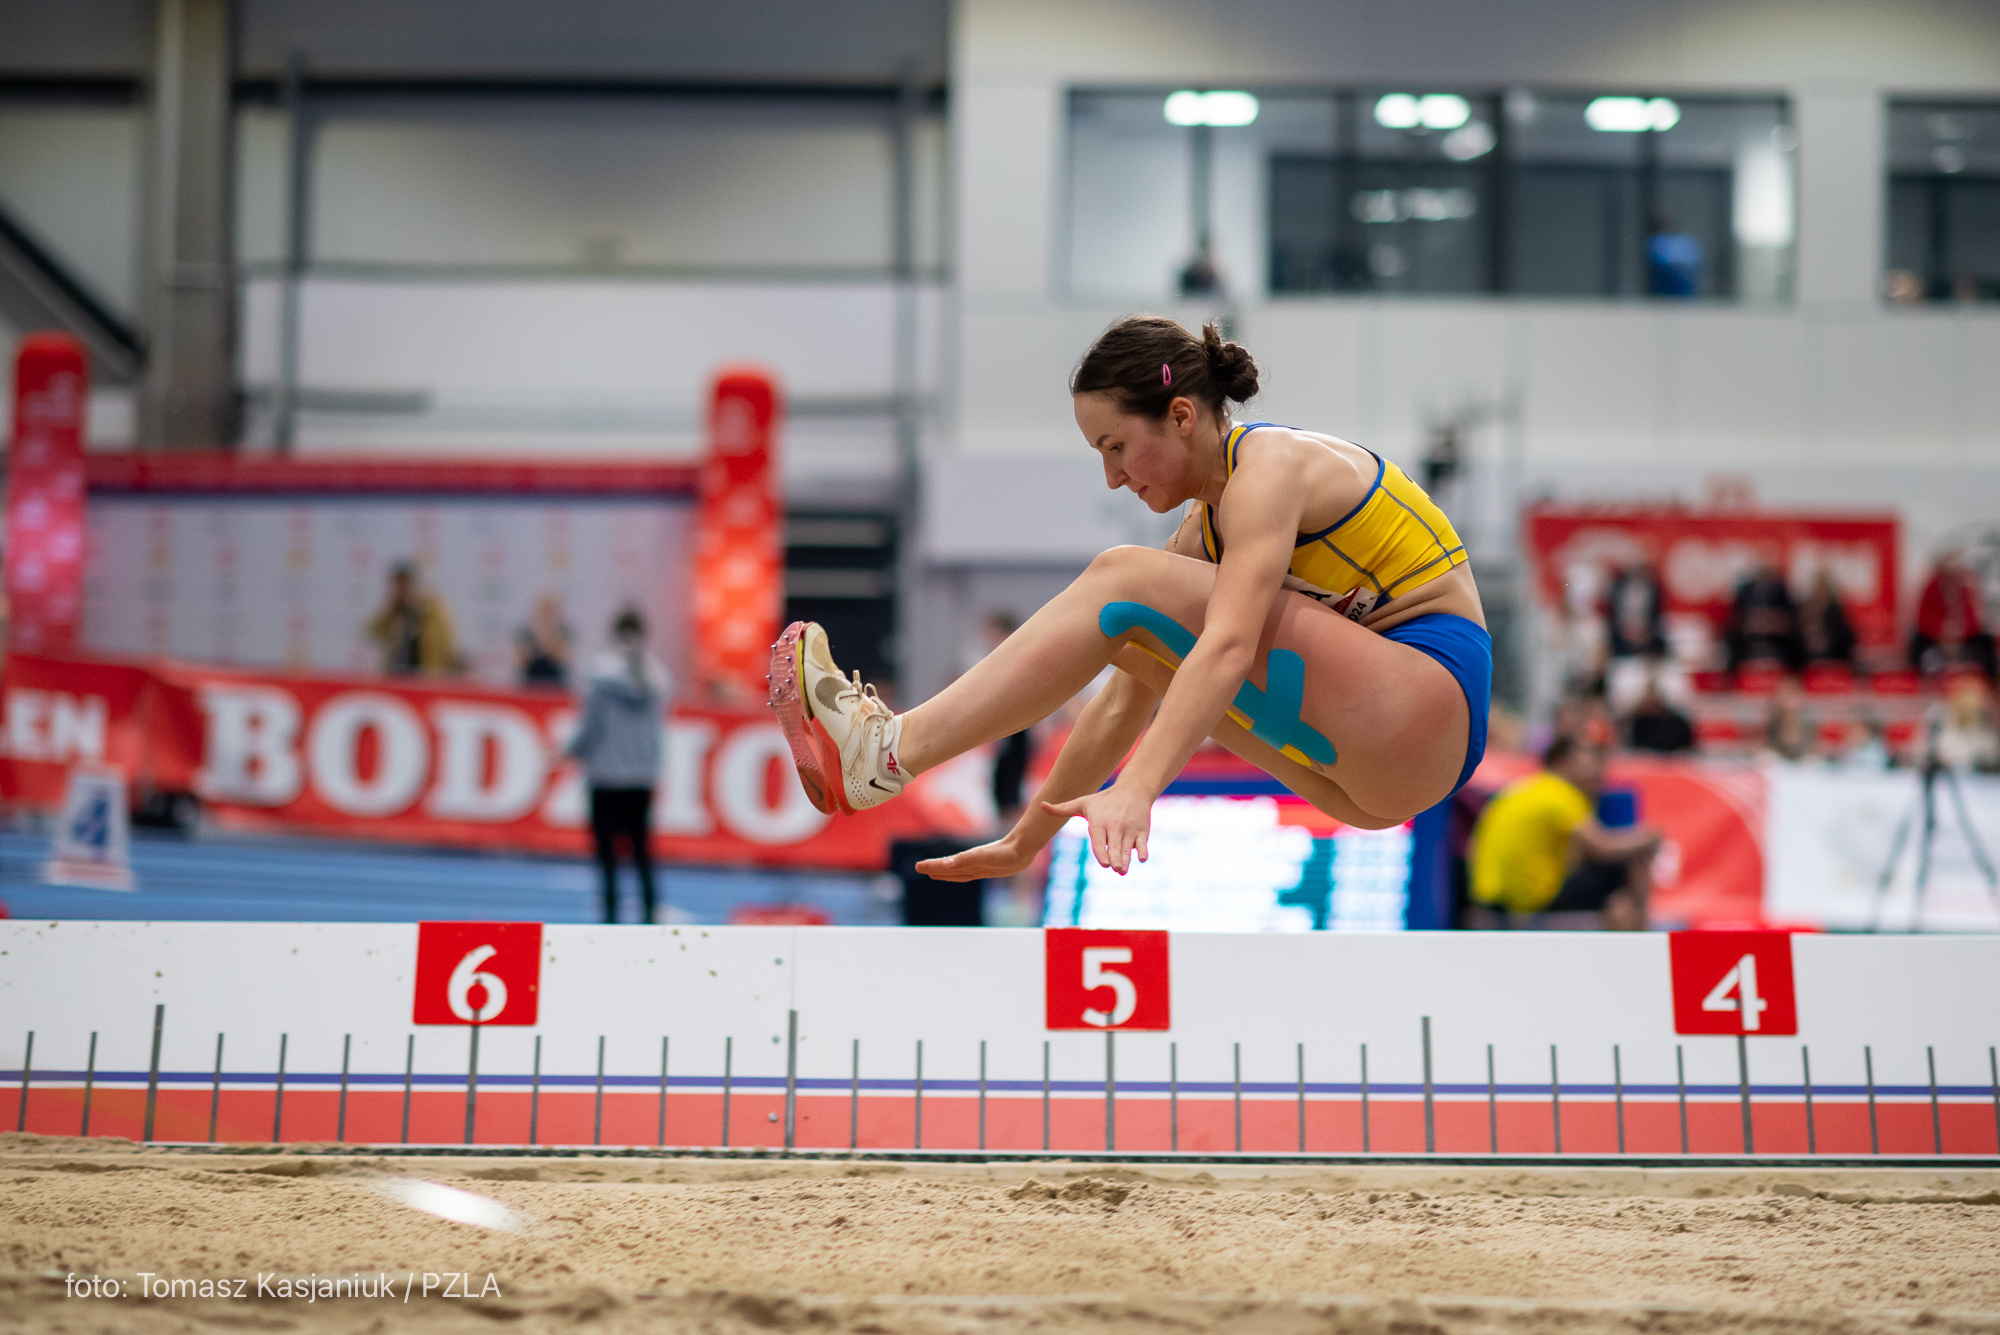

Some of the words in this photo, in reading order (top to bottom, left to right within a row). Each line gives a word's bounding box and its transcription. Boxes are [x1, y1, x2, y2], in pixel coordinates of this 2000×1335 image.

[1348, 601, 1367, 621] 024
[0, 688, 107, 760] EN
[447, 944, 508, 1022] 6
[1081, 946, 1137, 1027] 5
[1701, 953, 1767, 1031] 4
